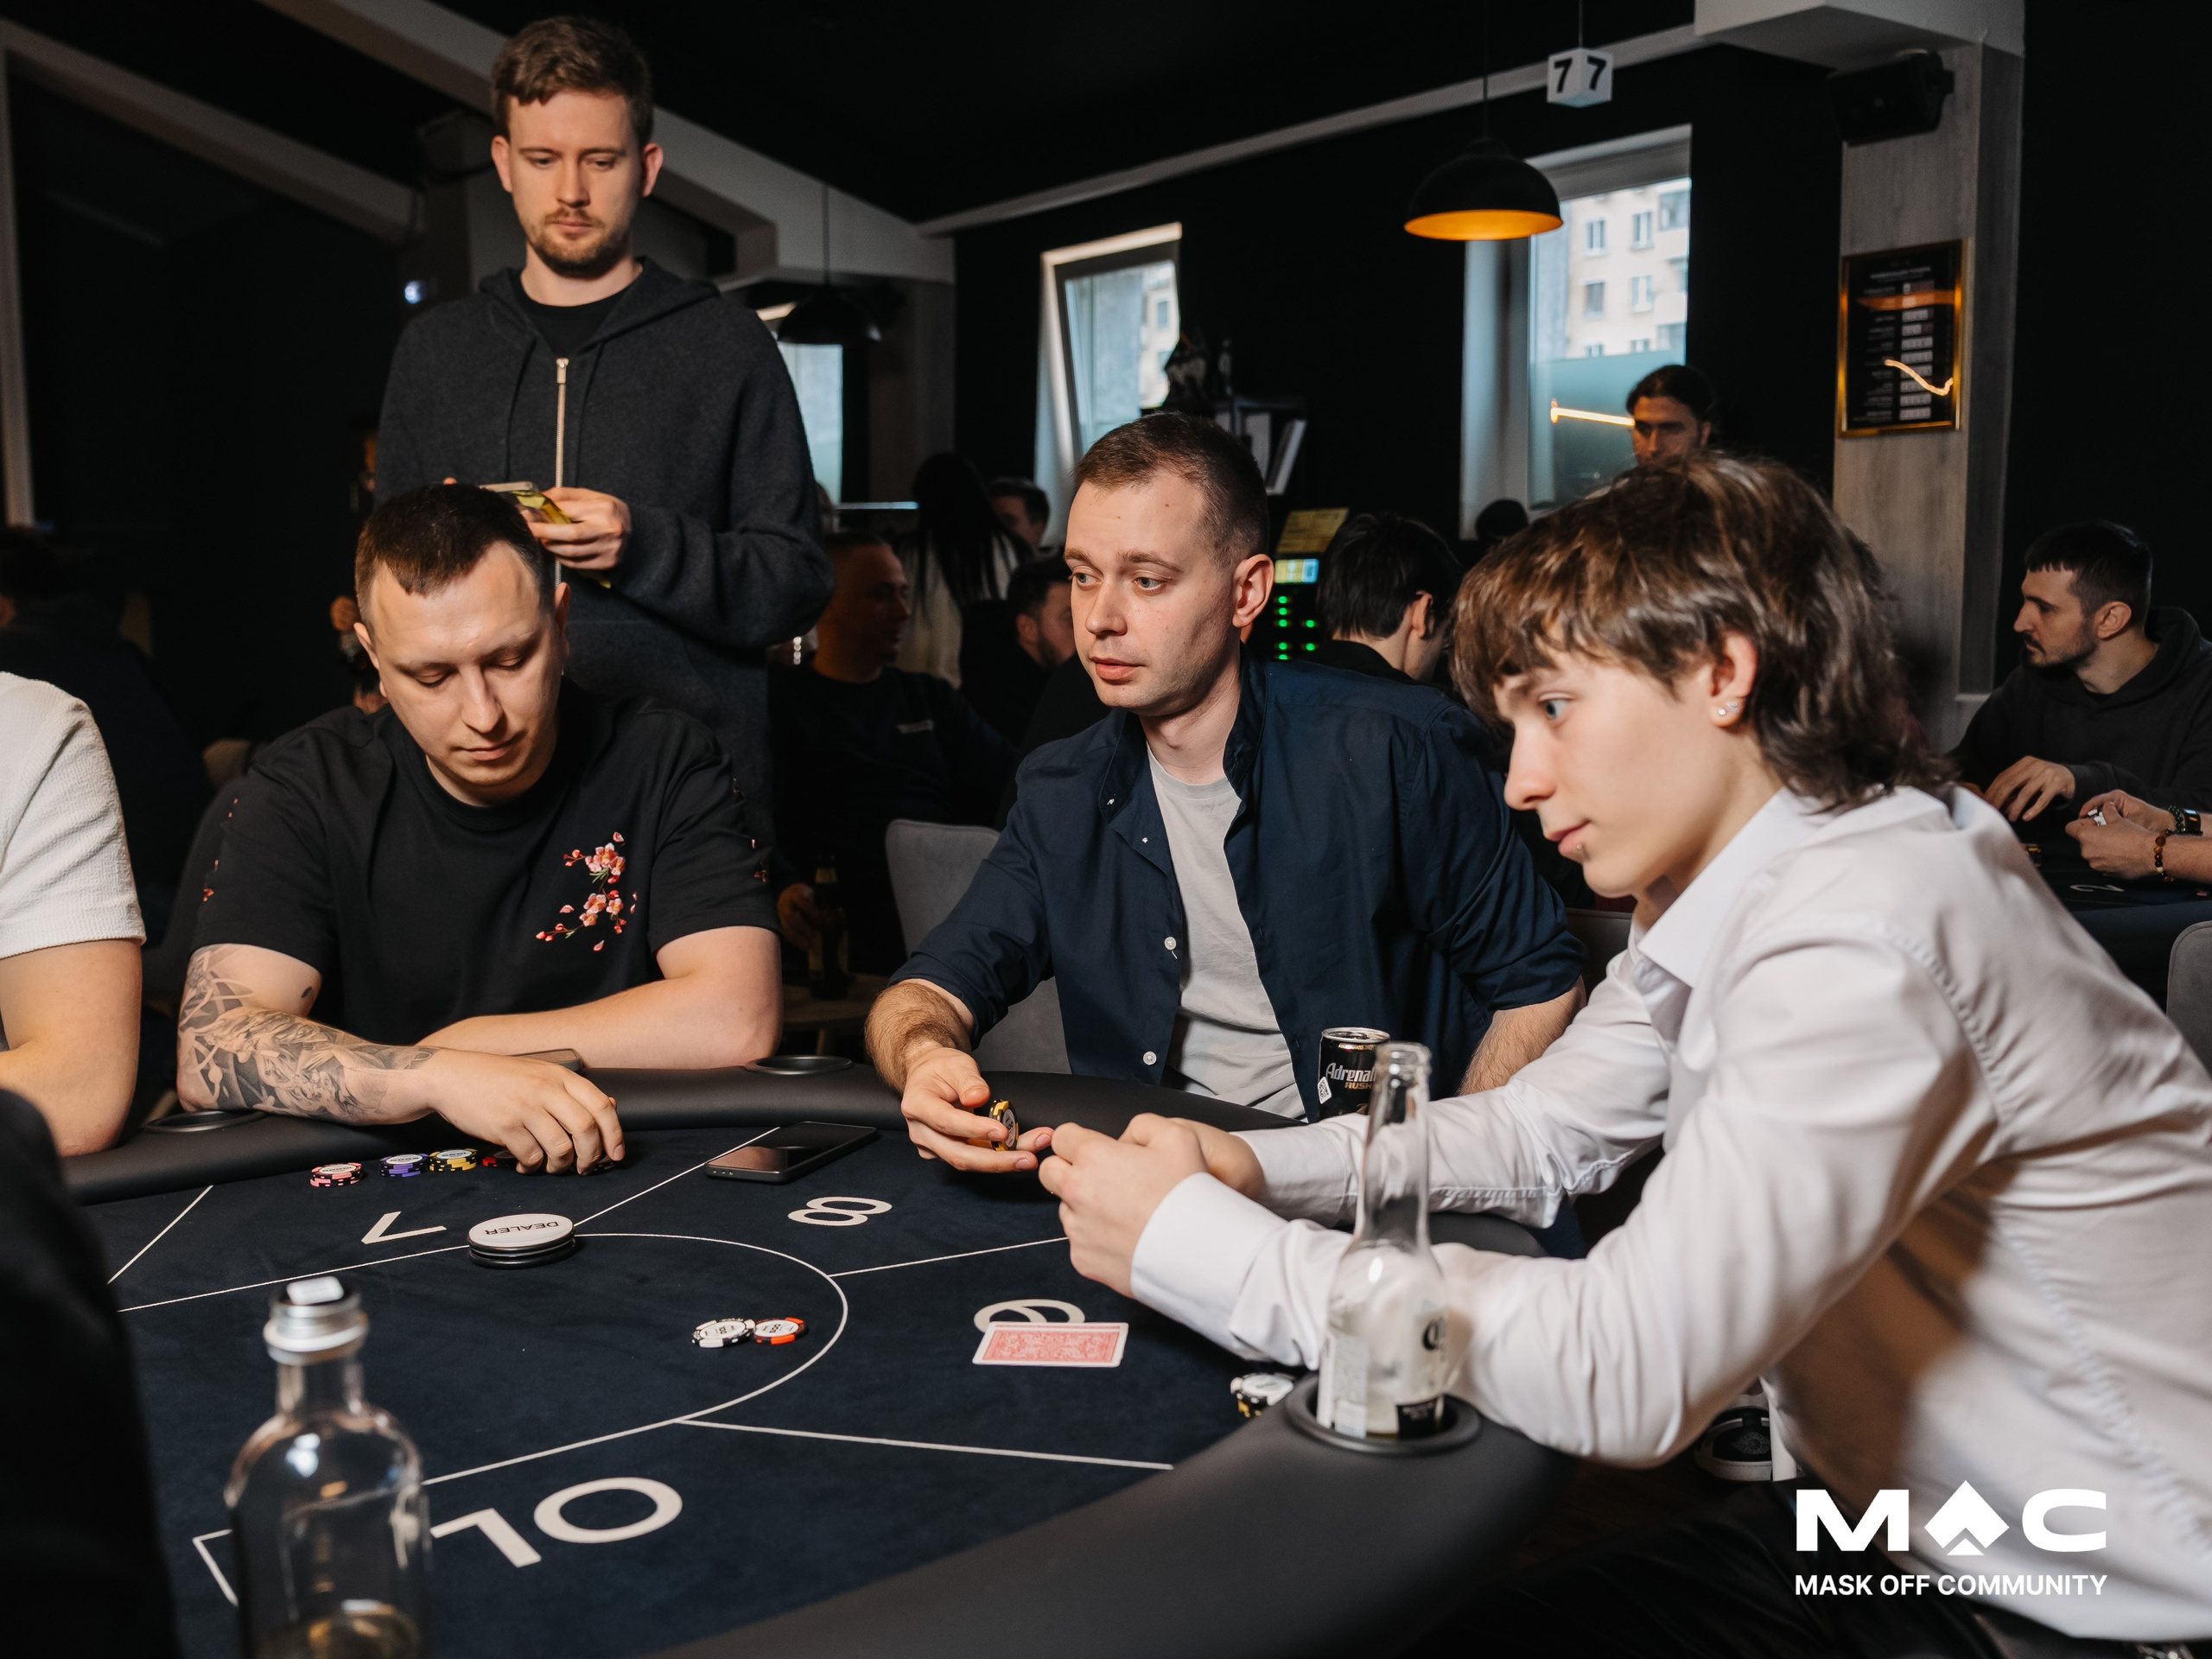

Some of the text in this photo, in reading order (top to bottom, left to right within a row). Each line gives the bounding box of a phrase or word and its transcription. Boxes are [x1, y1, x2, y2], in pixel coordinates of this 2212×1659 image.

[1554, 58, 1573, 93] 7
[1587, 55, 1607, 91] 7
[361, 1211, 447, 1244] 7
[485, 1221, 560, 1236] DEALER
[788, 1197, 893, 1226] 8
[430, 1477, 683, 1568] 10
